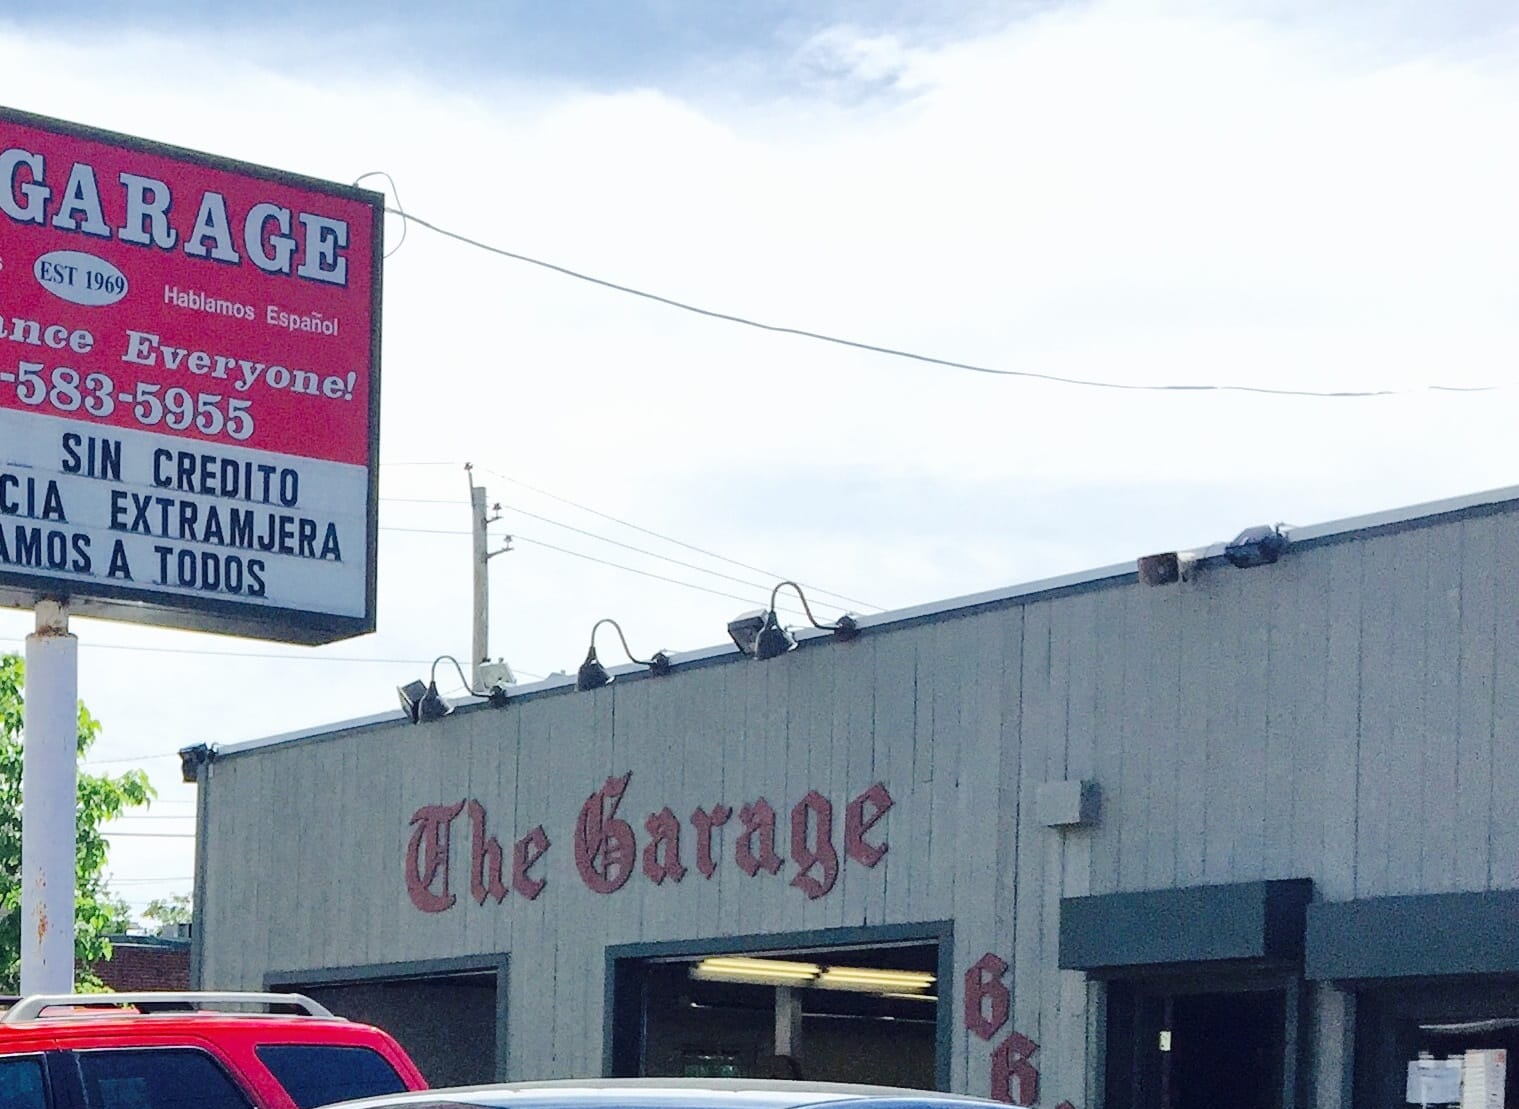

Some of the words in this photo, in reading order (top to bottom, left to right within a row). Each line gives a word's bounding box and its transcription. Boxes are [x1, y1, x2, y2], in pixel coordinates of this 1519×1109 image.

[39, 262, 78, 286] EST
[85, 270, 126, 296] 1969
[164, 284, 256, 322] Hablamos
[267, 305, 339, 337] Español
[121, 328, 357, 402] Everyone!
[62, 432, 122, 482] SIN
[153, 448, 299, 507] CREDITO
[111, 489, 342, 562] EXTRAMJERA
[108, 539, 134, 581] A
[154, 545, 267, 598] TODOS
[405, 798, 550, 914] The
[574, 769, 897, 901] Garage
